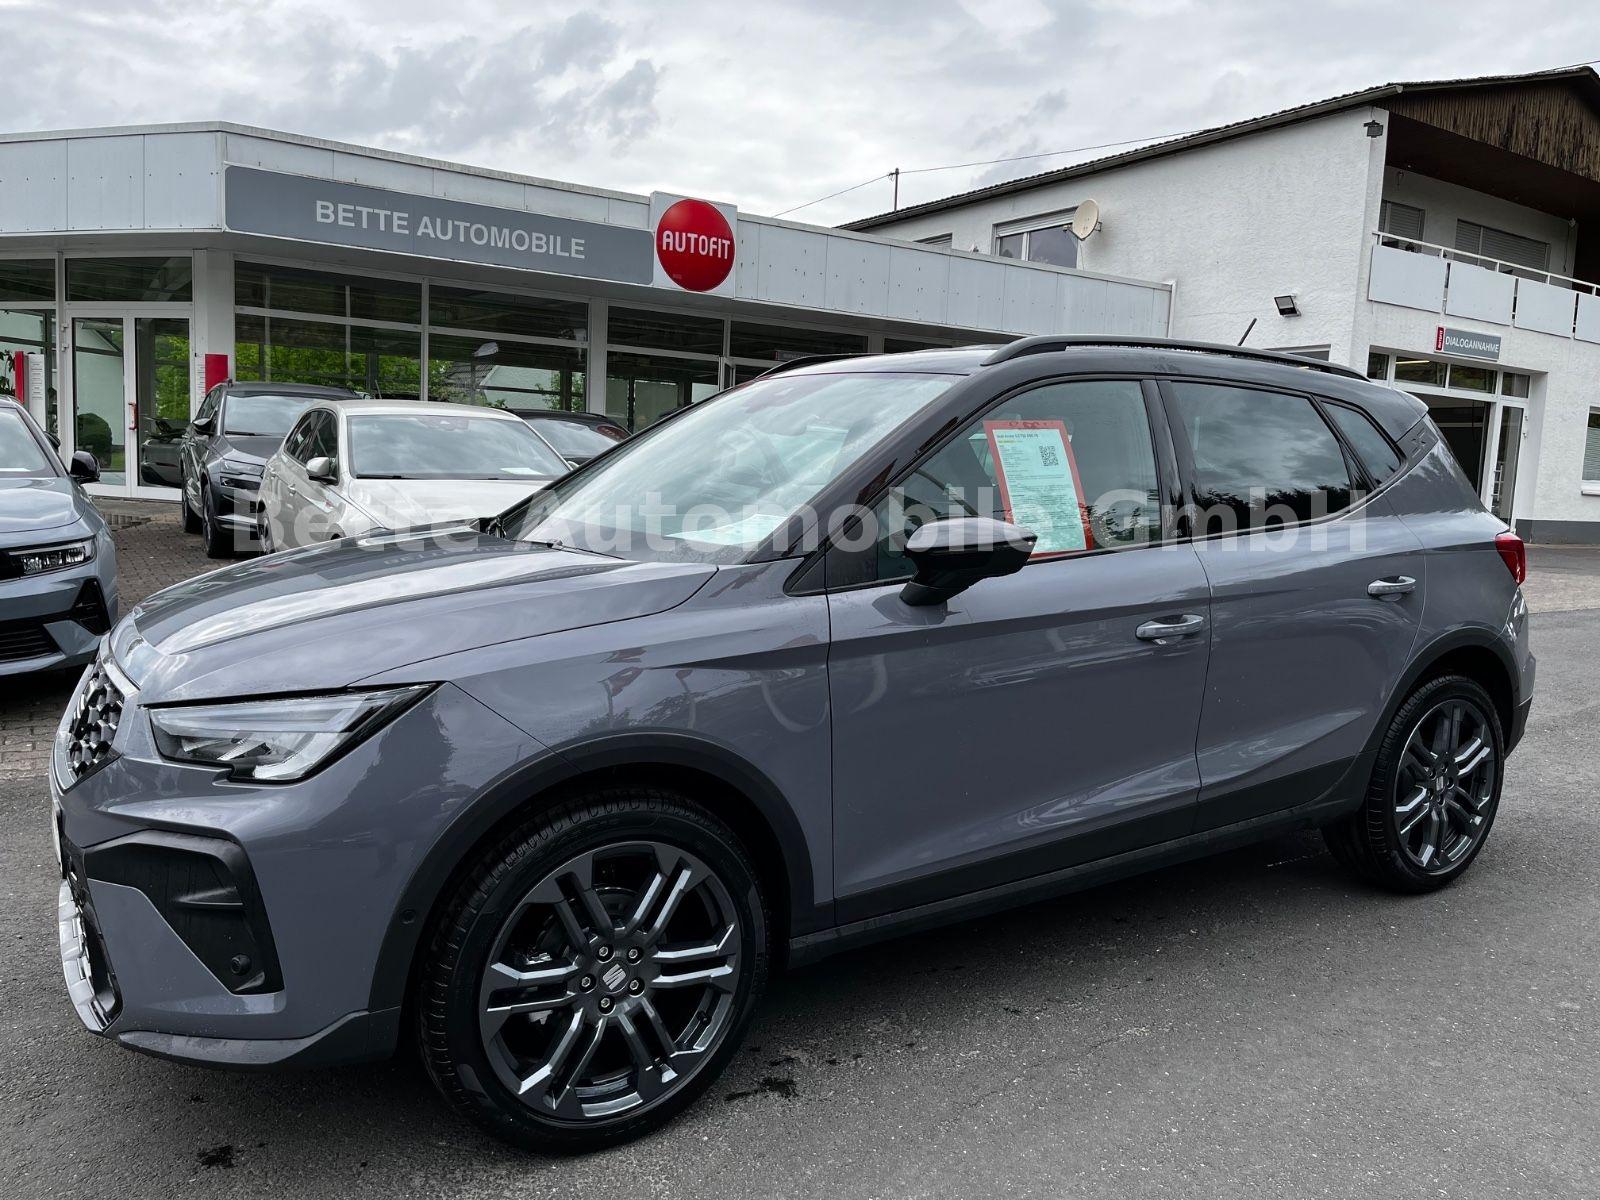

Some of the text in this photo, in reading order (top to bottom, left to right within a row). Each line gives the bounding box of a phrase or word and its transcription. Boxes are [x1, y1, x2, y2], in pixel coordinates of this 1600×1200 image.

[316, 200, 586, 260] BETTE AUTOMOBILE
[662, 230, 731, 260] AUTOFIT
[1445, 336, 1499, 352] DIALOGANNAHME
